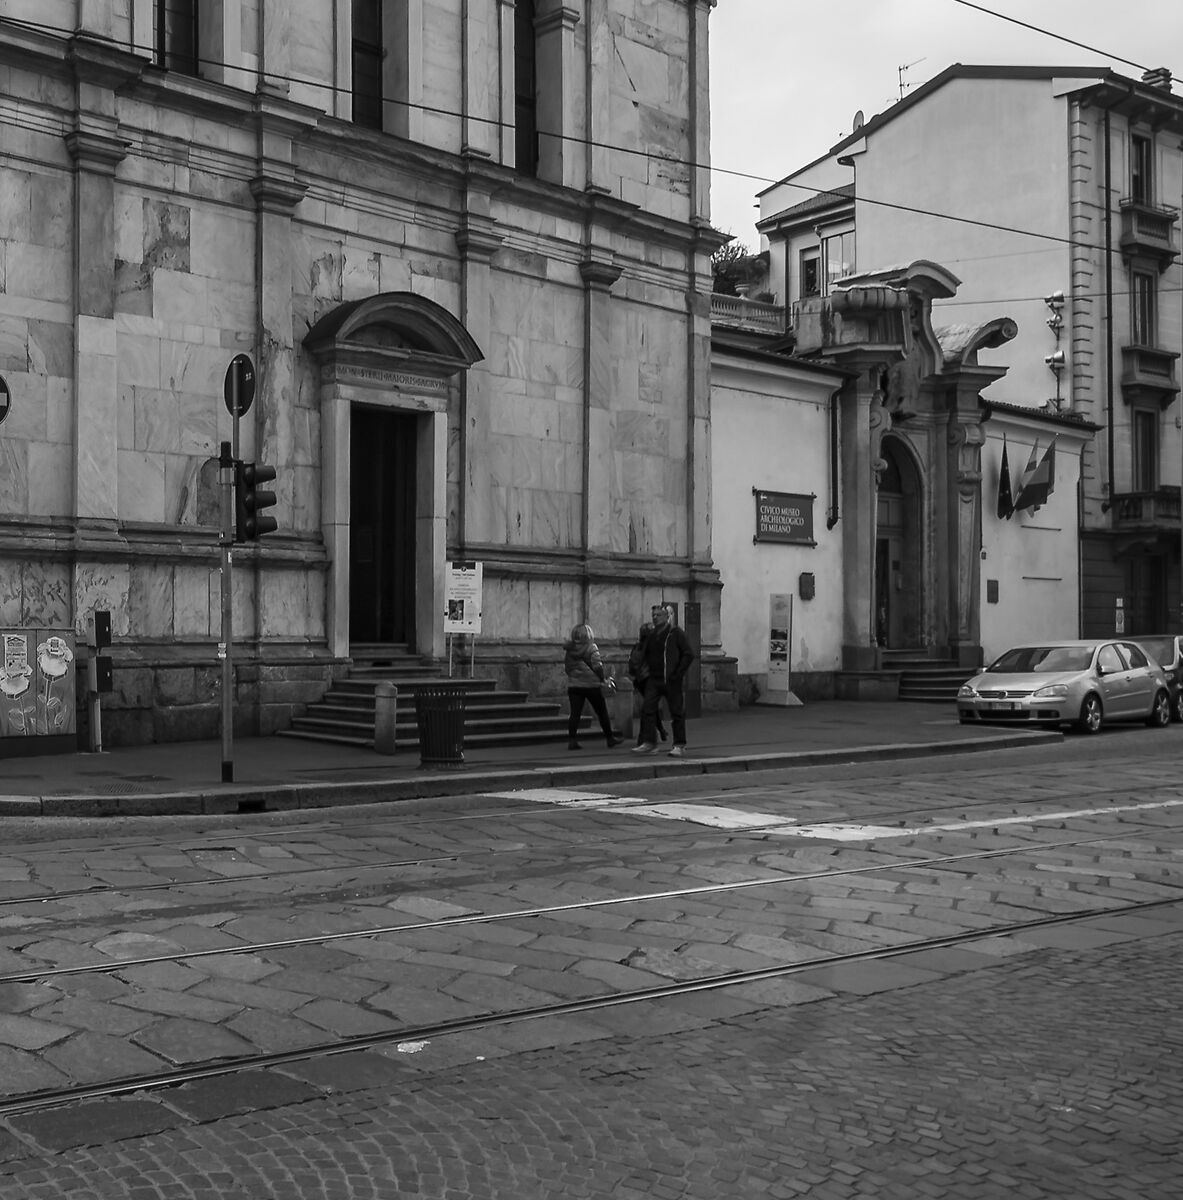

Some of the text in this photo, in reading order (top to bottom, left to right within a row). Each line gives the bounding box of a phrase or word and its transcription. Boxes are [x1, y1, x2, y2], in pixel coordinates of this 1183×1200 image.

[760, 505, 800, 517] CIVICO MUSEO
[760, 514, 804, 526] ARCHEOLOGICO
[760, 523, 791, 534] DI MILANO
